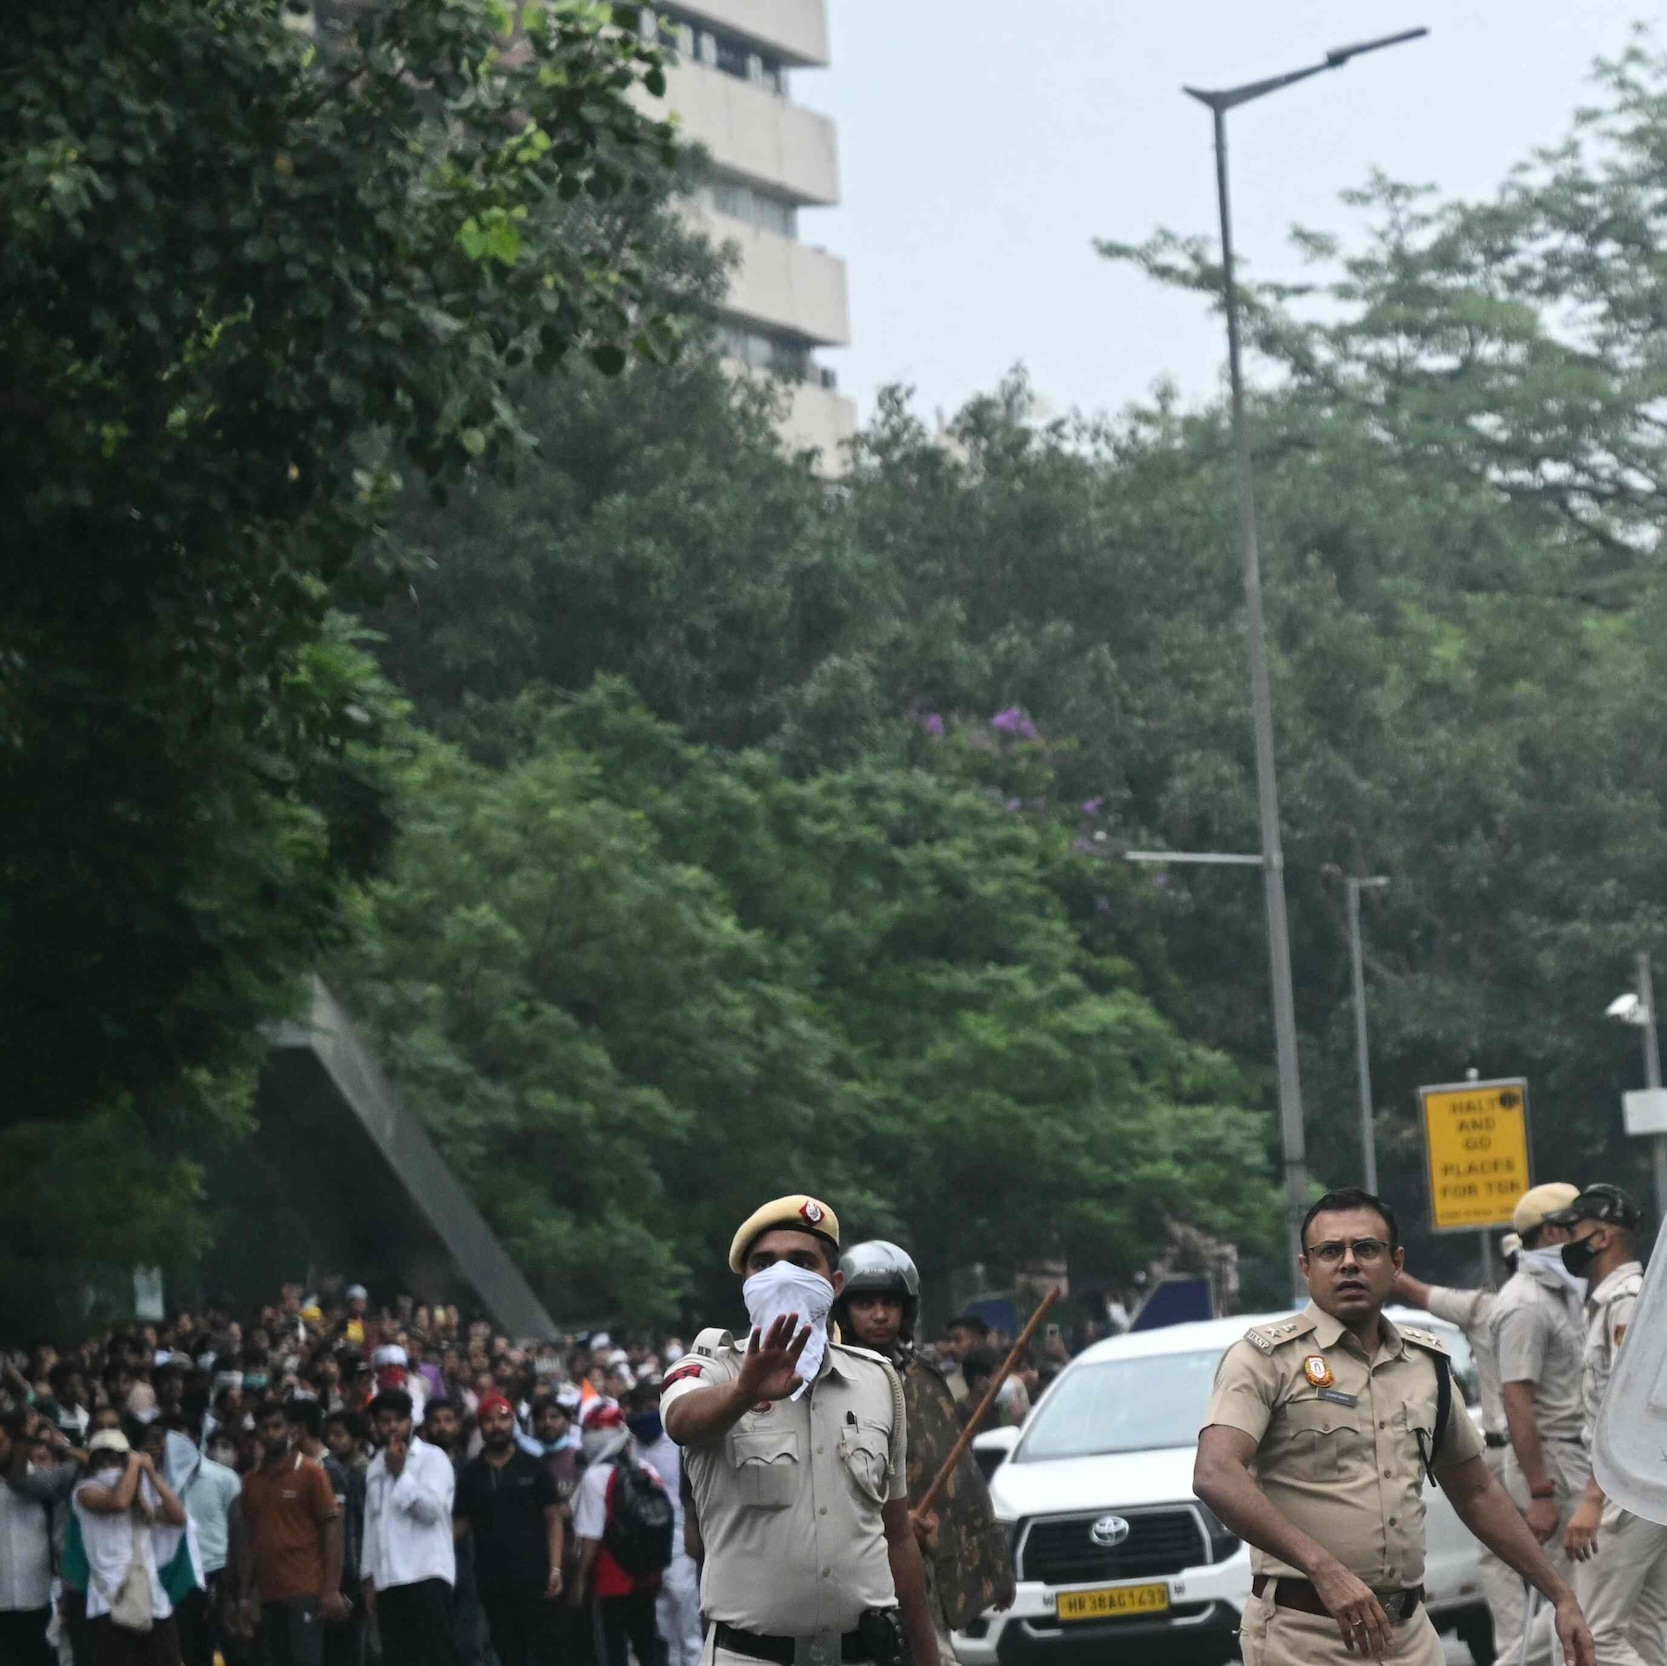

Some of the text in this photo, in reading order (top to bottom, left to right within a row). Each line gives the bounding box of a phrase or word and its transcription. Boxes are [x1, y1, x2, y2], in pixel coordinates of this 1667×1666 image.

[1452, 1098, 1497, 1114] HALT
[1457, 1118, 1496, 1132] AND
[1464, 1135, 1492, 1150] GO
[1441, 1157, 1516, 1177] PLACES
[1441, 1182, 1478, 1199] FOR
